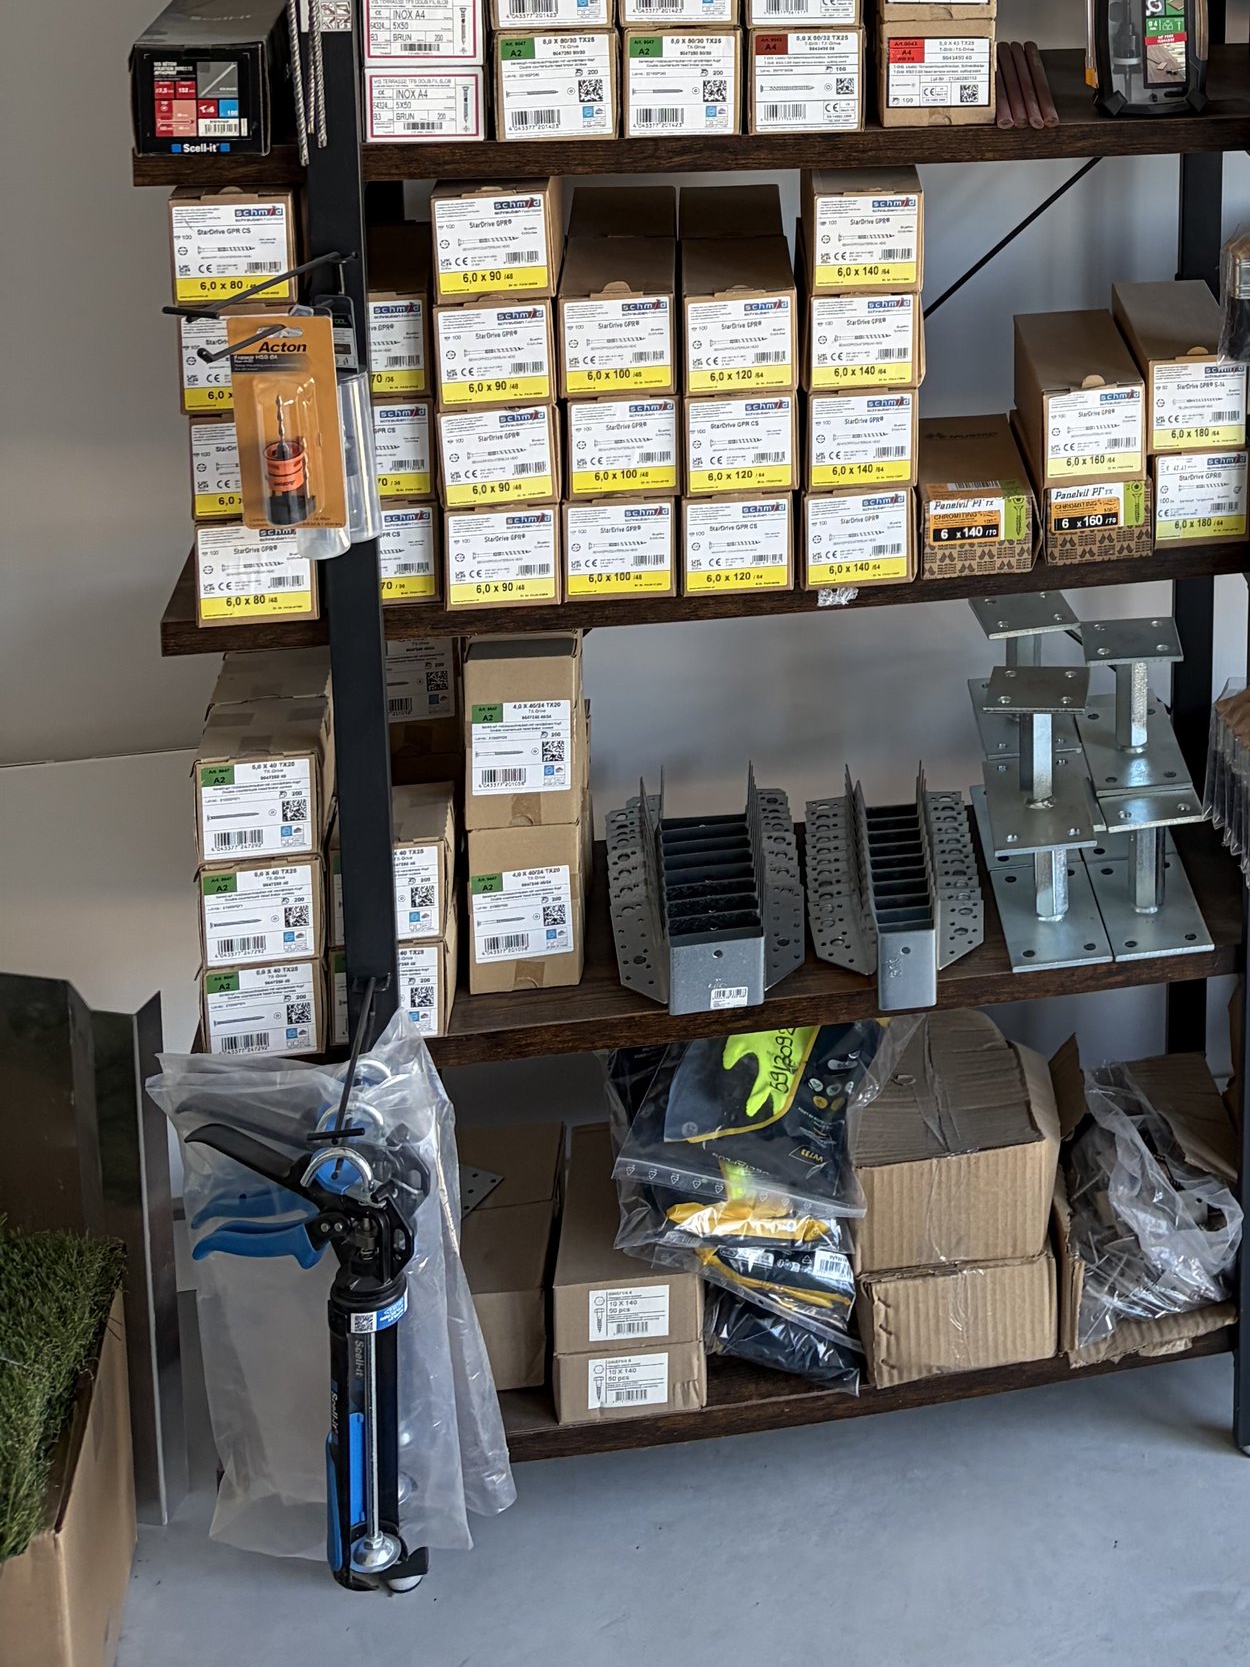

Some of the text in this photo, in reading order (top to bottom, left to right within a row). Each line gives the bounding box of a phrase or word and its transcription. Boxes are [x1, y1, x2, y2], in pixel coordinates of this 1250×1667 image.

[510, 49, 522, 57] A2
[494, 197, 541, 209] schmid
[235, 206, 283, 217] schmid
[463, 273, 478, 284] 6,0
[490, 271, 501, 281] 90
[837, 266, 878, 278] 6,0 x 140
[200, 281, 216, 291] 6,0
[230, 281, 243, 289] 80
[498, 308, 544, 321] schmid
[259, 342, 307, 352] Acton
[710, 371, 725, 382] 6,0
[736, 370, 752, 380] 120
[1066, 457, 1080, 467] 6,0
[1090, 455, 1105, 465] 160
[941, 529, 948, 539] 6
[354, 1338, 363, 1377] Scell-it
